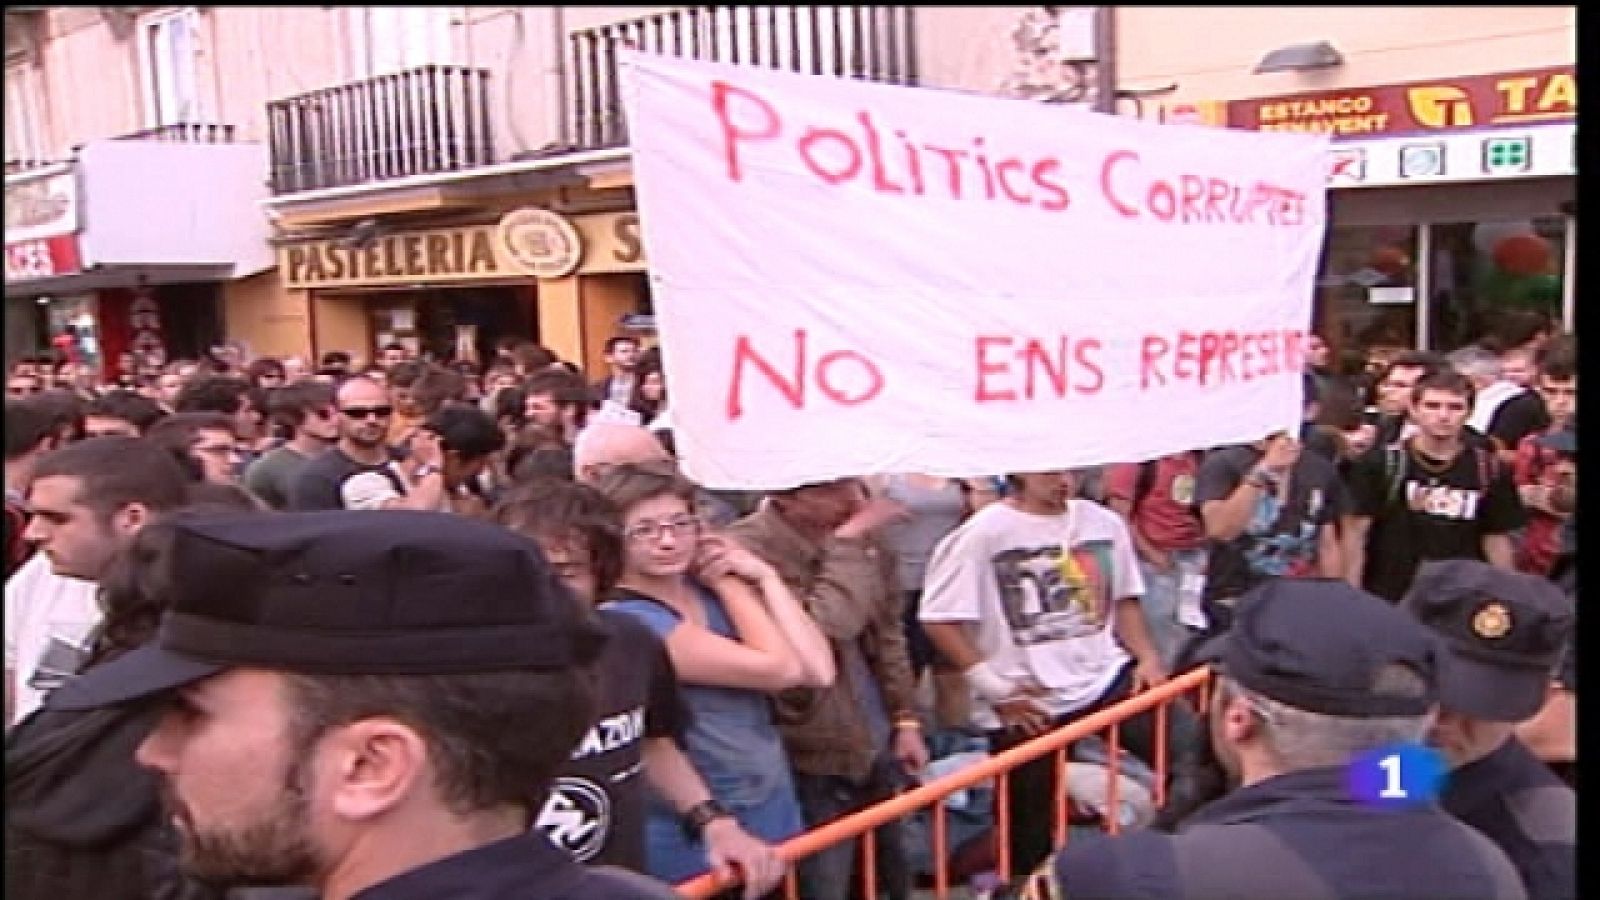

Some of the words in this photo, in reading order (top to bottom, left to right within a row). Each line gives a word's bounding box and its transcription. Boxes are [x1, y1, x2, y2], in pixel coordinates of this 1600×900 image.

[1259, 96, 1374, 121] ESTANCO
[287, 229, 498, 284] PASTELERIA
[725, 327, 886, 421] NO
[973, 334, 1104, 403] ENS
